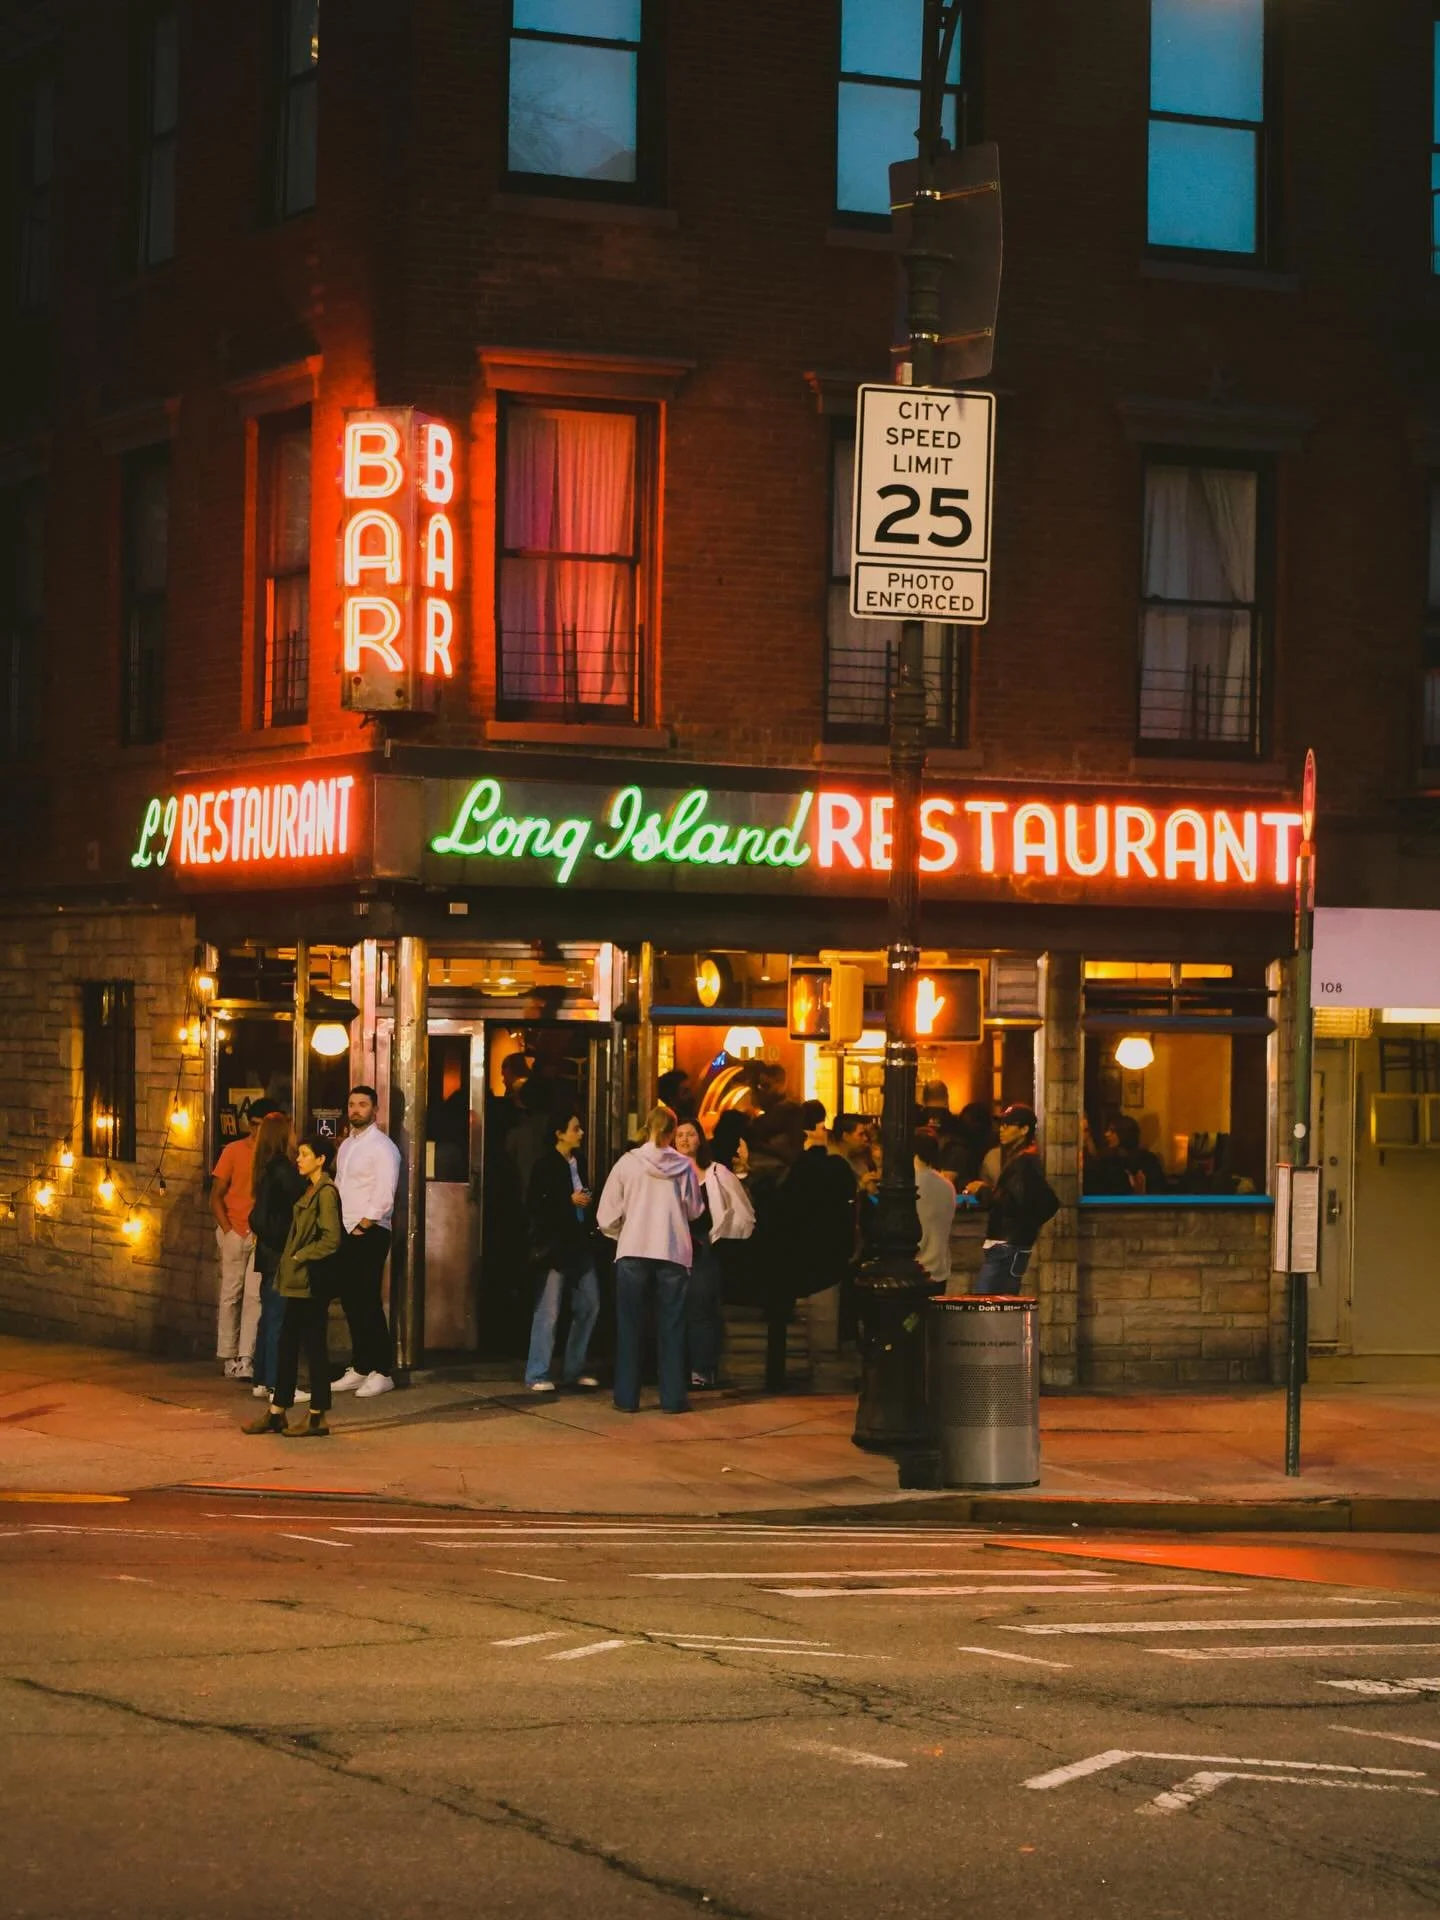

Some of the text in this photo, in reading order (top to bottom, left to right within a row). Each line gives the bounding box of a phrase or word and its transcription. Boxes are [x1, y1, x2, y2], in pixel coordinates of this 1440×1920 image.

[899, 401, 951, 422] CITY
[886, 427, 961, 449] SPEED
[893, 454, 953, 475] LIMIT
[874, 483, 972, 547] 25
[344, 421, 405, 673] BAR
[424, 422, 454, 676] BAR
[888, 572, 954, 591] PHOTO
[866, 591, 974, 611] ENFORCED
[180, 775, 354, 865] RESTAURANT
[431, 778, 1304, 885] Long Island RESTAURANT
[1320, 982, 1343, 993] 108
